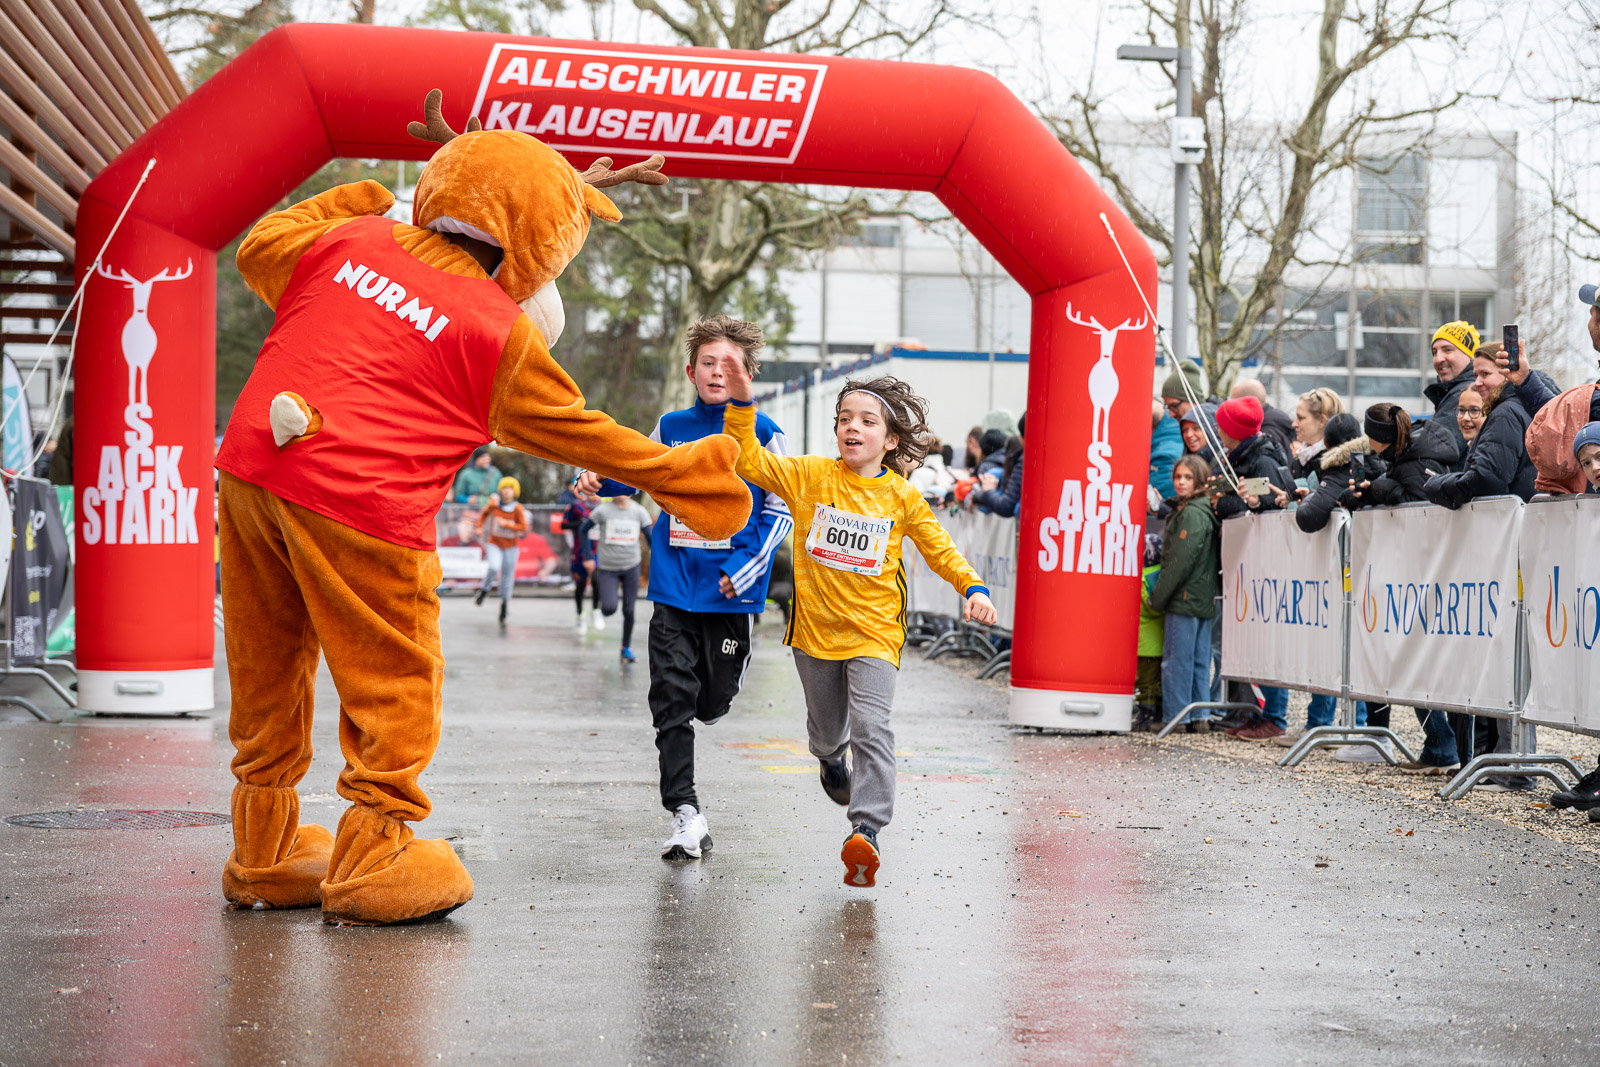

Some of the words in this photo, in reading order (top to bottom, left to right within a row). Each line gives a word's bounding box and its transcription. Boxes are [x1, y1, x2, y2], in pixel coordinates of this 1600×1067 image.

[497, 56, 807, 103] ALLSCHWILER
[485, 100, 793, 148] KLAUSENLAUF
[333, 259, 450, 342] NURMI
[83, 486, 199, 545] STARK
[826, 527, 869, 551] 6010
[829, 514, 886, 533] NOVARTIS
[1038, 517, 1141, 577] STARK
[1251, 578, 1329, 628] NOVARTIS
[1384, 580, 1499, 638] NOVARTIS
[722, 638, 738, 655] GR
